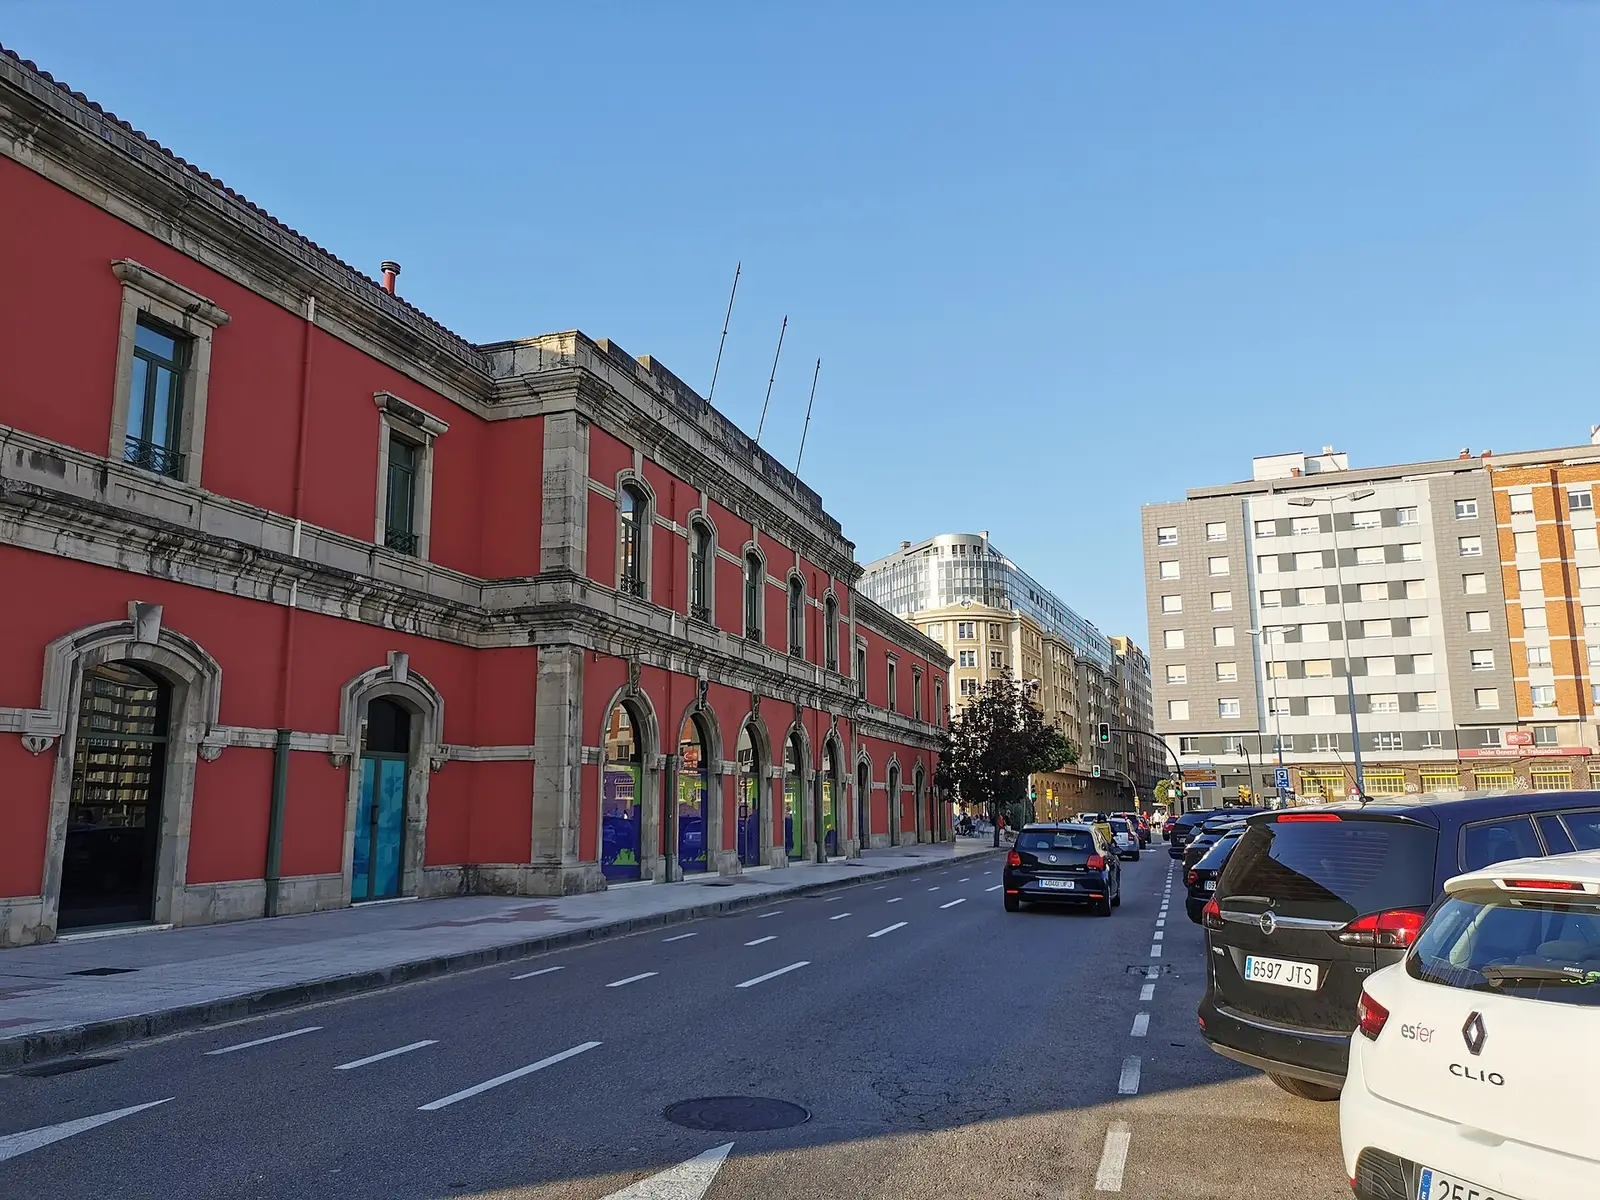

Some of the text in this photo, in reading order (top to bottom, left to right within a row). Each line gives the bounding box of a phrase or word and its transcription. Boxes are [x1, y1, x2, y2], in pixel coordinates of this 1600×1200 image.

[1477, 748, 1563, 756] Unión General de Trabajadores
[1253, 960, 1312, 985] 6597 JTS
[1401, 1022, 1435, 1043] esfer
[1449, 1063, 1505, 1086] CLIO
